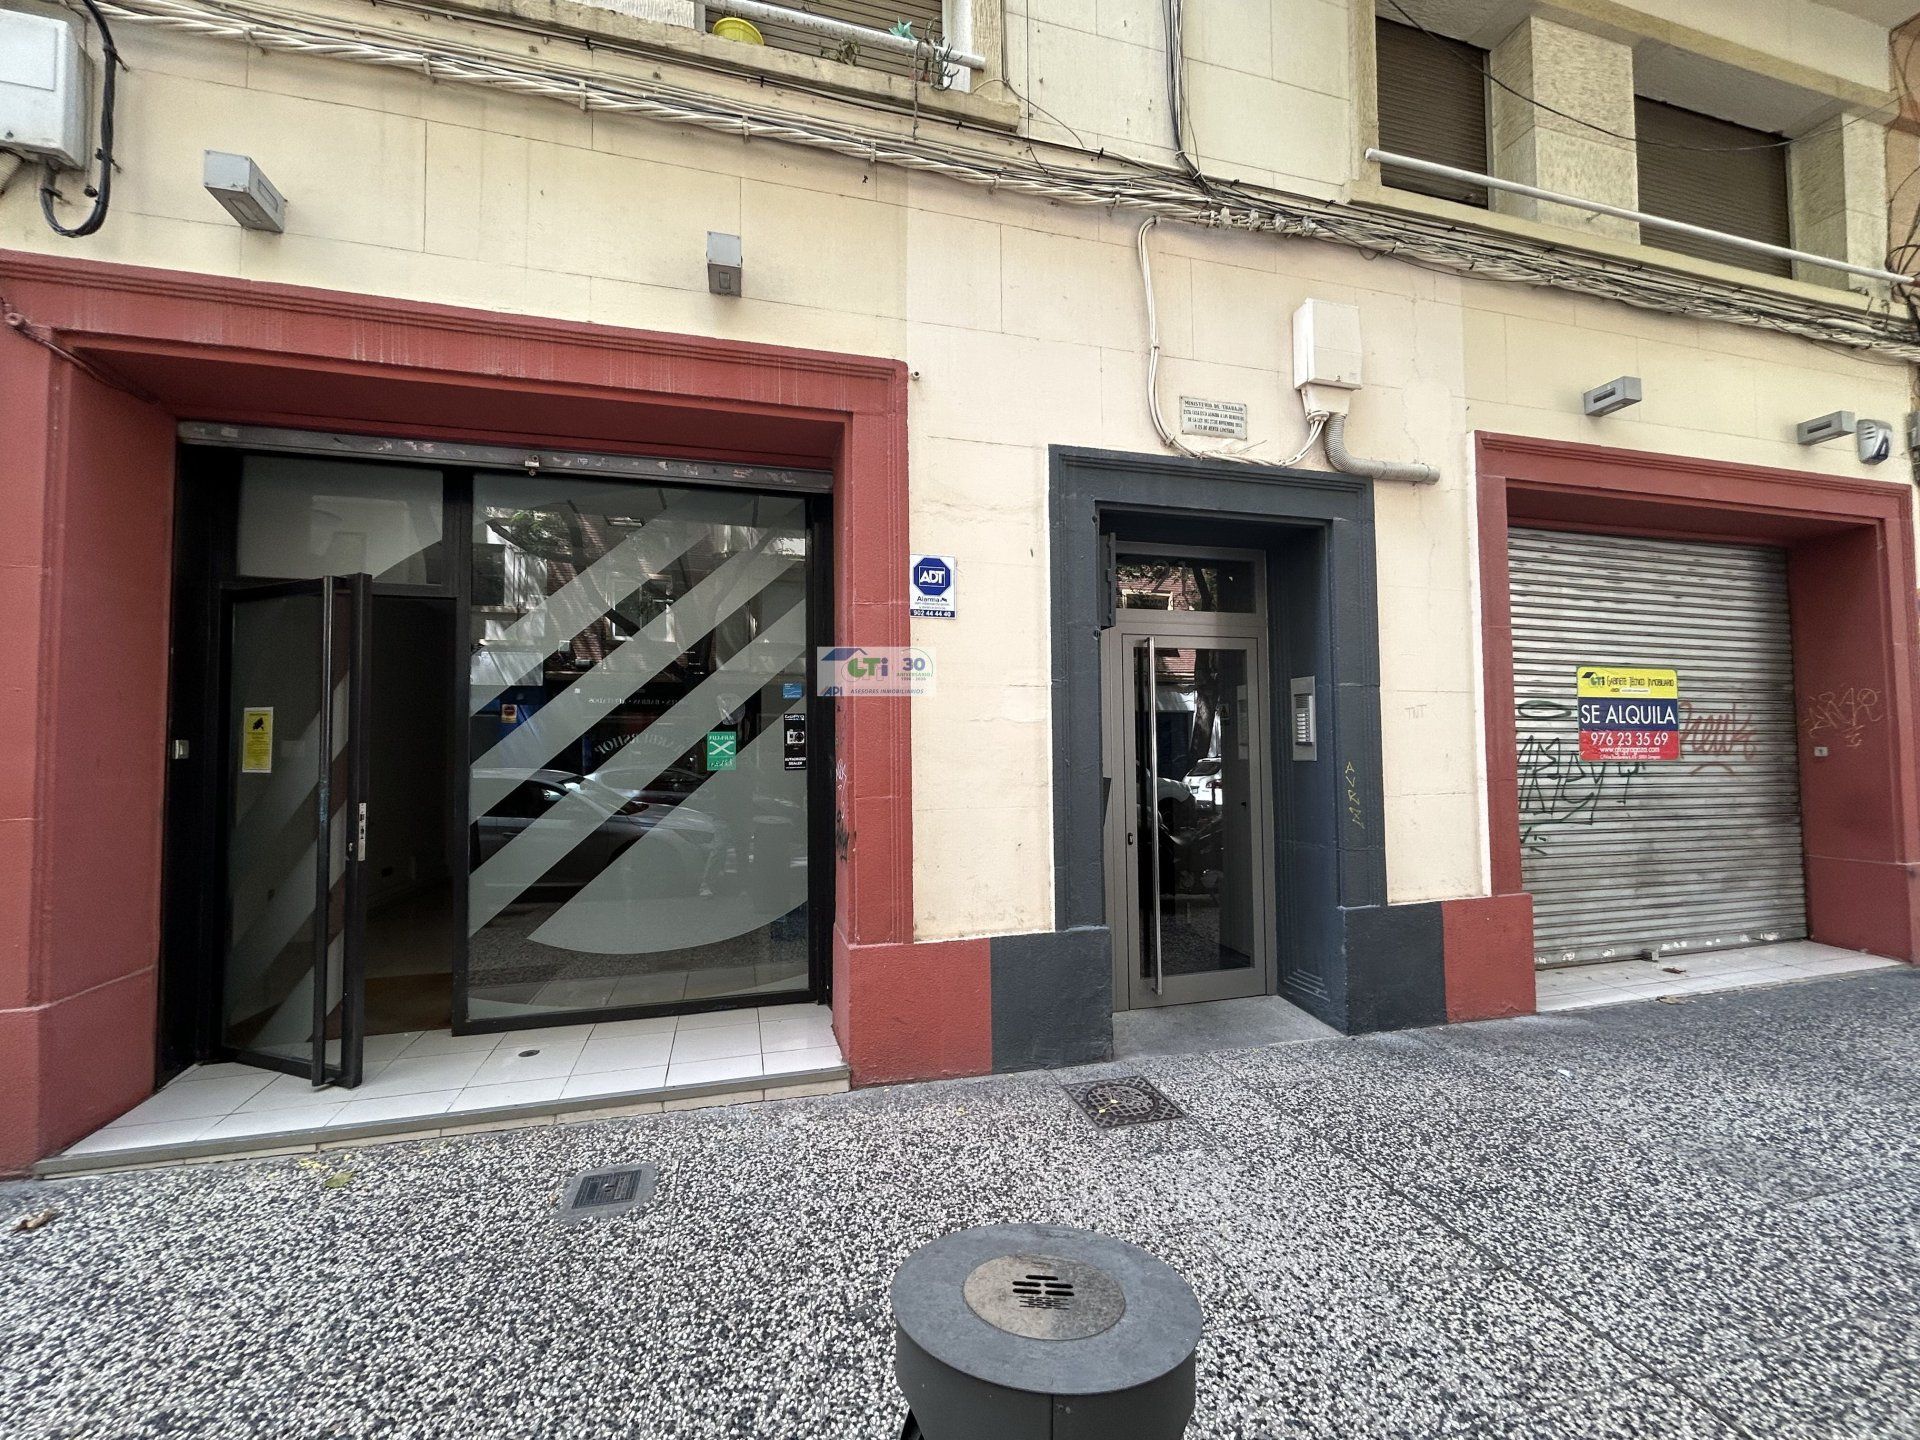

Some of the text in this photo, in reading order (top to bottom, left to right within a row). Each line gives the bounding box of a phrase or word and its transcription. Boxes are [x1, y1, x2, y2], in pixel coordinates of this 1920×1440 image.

[920, 570, 944, 584] ADT
[1581, 705, 1676, 724] SE ALQUILA
[1591, 732, 1668, 747] 976 23 35 69
